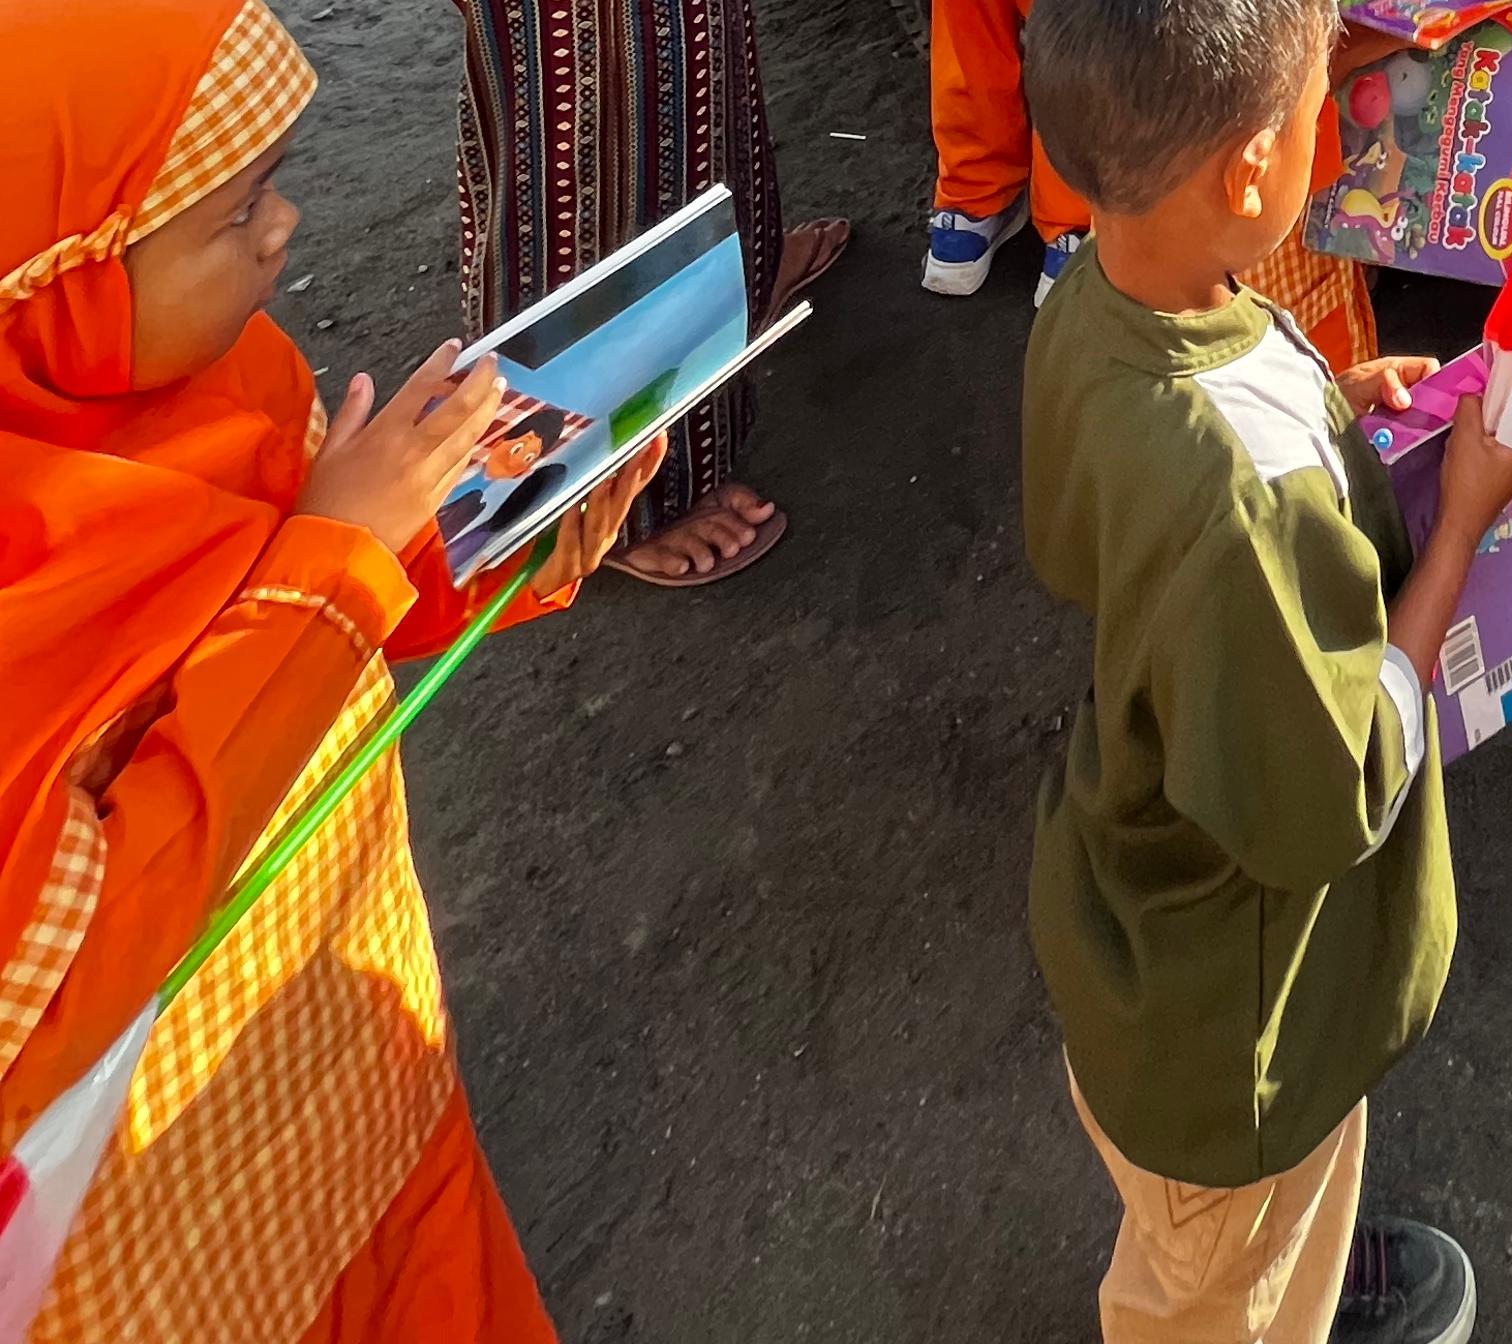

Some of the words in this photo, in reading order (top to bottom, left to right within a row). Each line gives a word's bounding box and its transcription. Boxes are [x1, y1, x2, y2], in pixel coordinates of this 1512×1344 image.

[1451, 40, 1475, 80] Yang
[1442, 48, 1503, 250] Katak-katak
[1427, 179, 1450, 245] Kerbau
[1494, 190, 1505, 210] FULL
[1498, 190, 1512, 248] BILINGUAL
